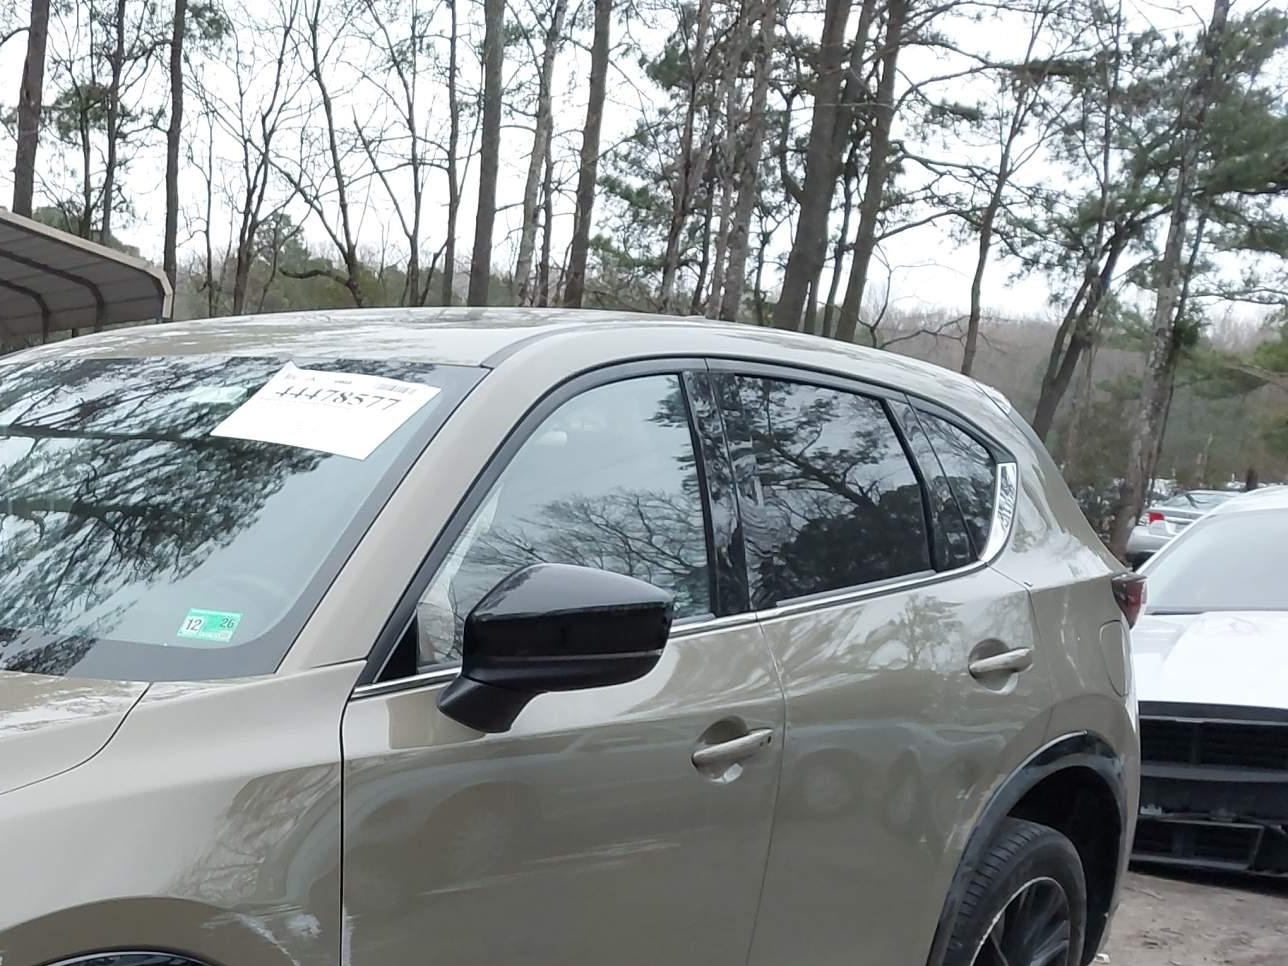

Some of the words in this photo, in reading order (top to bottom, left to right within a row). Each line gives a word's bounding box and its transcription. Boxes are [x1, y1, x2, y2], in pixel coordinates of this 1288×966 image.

[274, 385, 403, 411] 44478577
[185, 618, 203, 632] 12
[219, 617, 235, 629] 26
